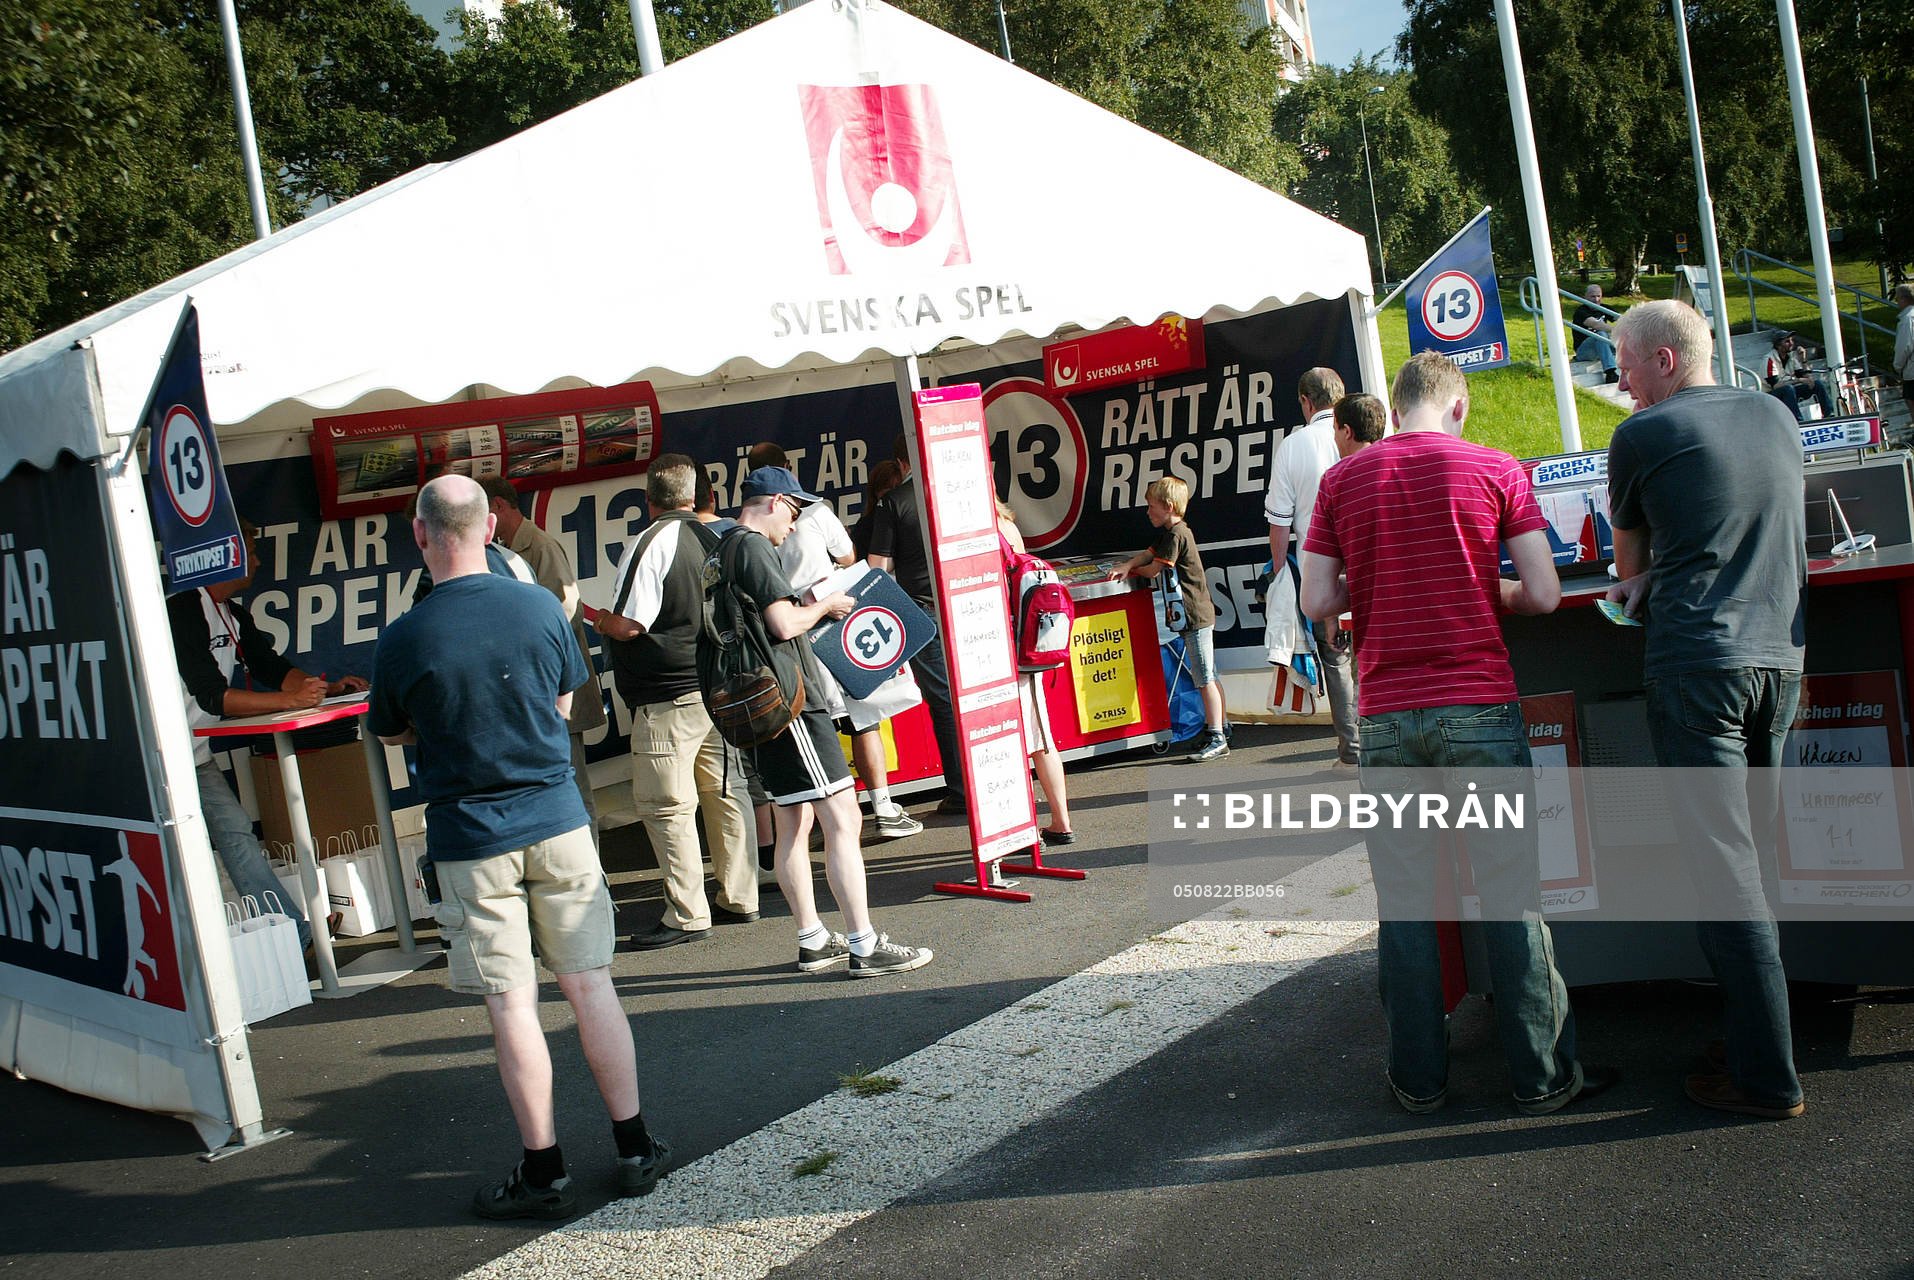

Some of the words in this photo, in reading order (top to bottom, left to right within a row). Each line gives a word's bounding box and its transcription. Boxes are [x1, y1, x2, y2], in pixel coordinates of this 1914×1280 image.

[770, 293, 942, 337] SVENSKA
[955, 284, 1033, 321] SPEL
[1431, 288, 1472, 324] 13
[1448, 349, 1484, 366] TIPSET
[1086, 363, 1132, 382] SVENSKA
[1135, 357, 1160, 372] SPEL
[1101, 377, 1207, 449] RÄTT
[1213, 364, 1275, 431] ÄR
[1801, 425, 1842, 438] ORT
[171, 436, 205, 495] 13
[816, 432, 869, 493] ÄR
[990, 424, 1061, 503] 13
[1538, 457, 1594, 475] SPORT
[1538, 464, 1595, 483] BAGEN
[561, 488, 648, 580] 13
[175, 545, 225, 577] STRYKTIPSET
[1, 533, 56, 634] ÄR
[855, 617, 893, 659] 13
[1073, 628, 1125, 648] Plötsligt
[1080, 648, 1124, 666] händer
[1092, 668, 1117, 683] det!
[1102, 707, 1127, 719] TRISS
[1846, 702, 1884, 719] idag
[1529, 724, 1563, 738] idag
[1801, 792, 1883, 809] HAMMARBY
[0, 845, 99, 960] IPSET
[1820, 889, 1891, 898] MATCHEN
